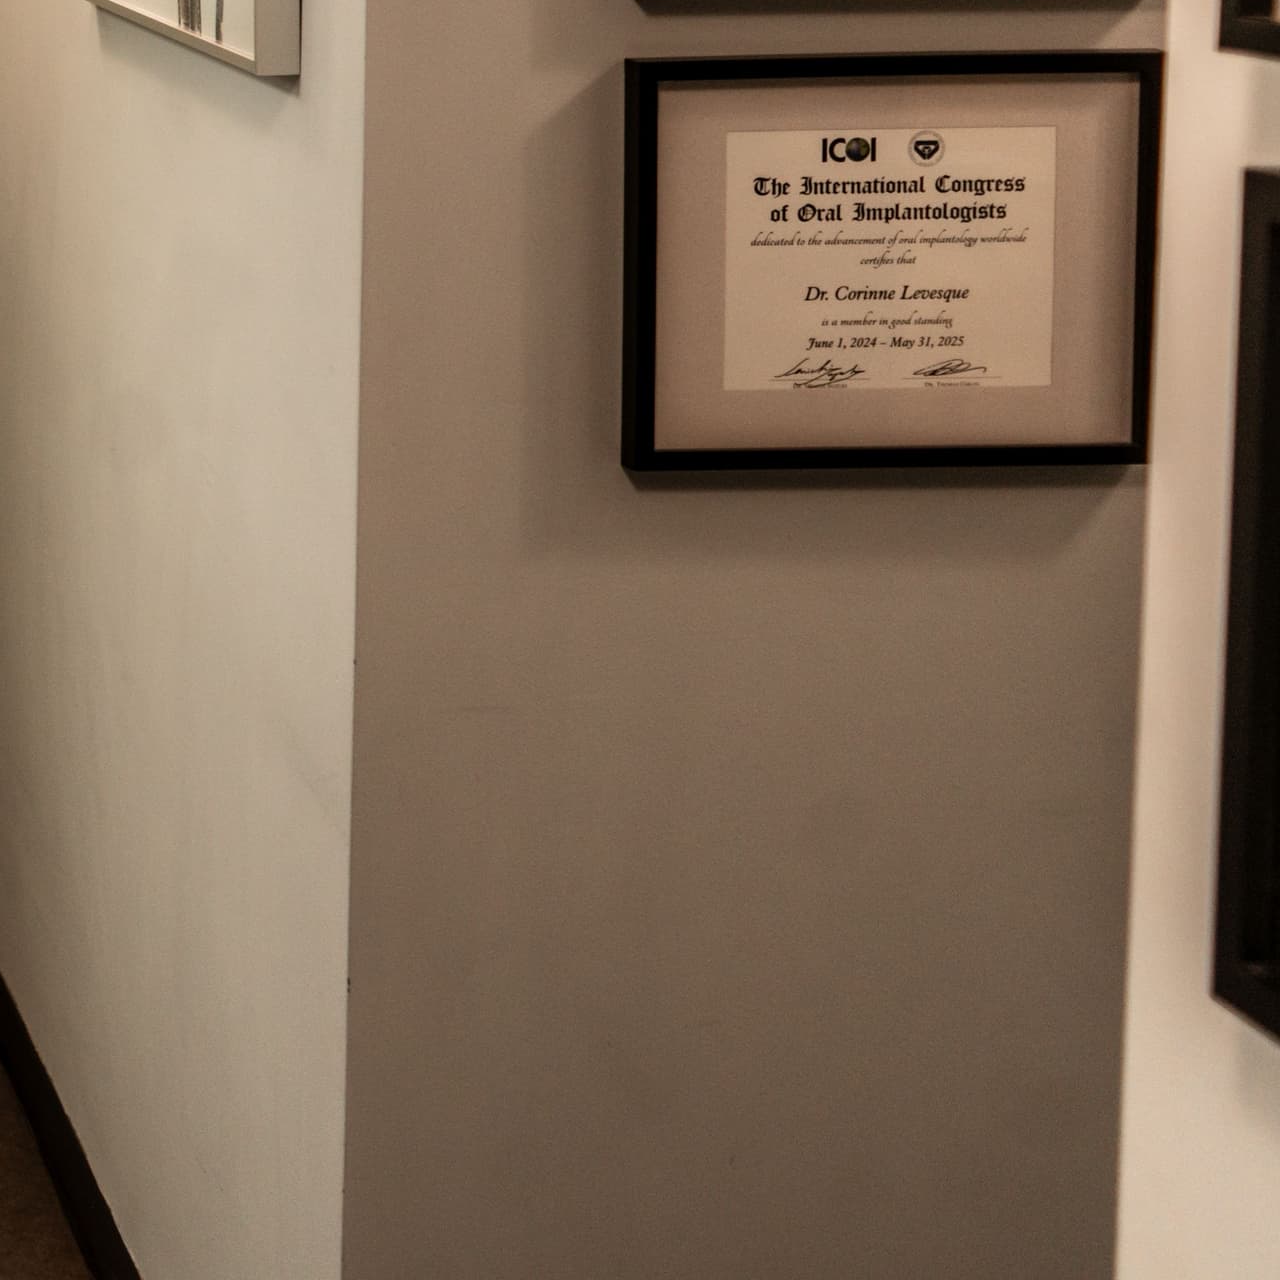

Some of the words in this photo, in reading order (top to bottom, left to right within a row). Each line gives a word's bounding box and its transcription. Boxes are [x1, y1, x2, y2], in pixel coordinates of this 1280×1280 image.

[753, 177, 790, 198] The
[799, 176, 925, 196] International
[935, 174, 1026, 196] Congress
[770, 204, 789, 223] of
[797, 203, 843, 222] Oral
[852, 202, 1007, 224] Implantologists
[750, 231, 795, 247] dedicated
[824, 230, 886, 245] advancement
[919, 228, 978, 247] implantology
[896, 250, 917, 264] that
[804, 286, 829, 301] Dr.
[835, 285, 895, 301] Corinne
[900, 285, 970, 302] Levesque
[840, 311, 877, 327] member
[913, 310, 953, 328] standing
[806, 337, 834, 350] June
[849, 337, 877, 348] 2024
[890, 337, 915, 350] May
[918, 336, 934, 349] 31,
[937, 336, 964, 347] 2025
